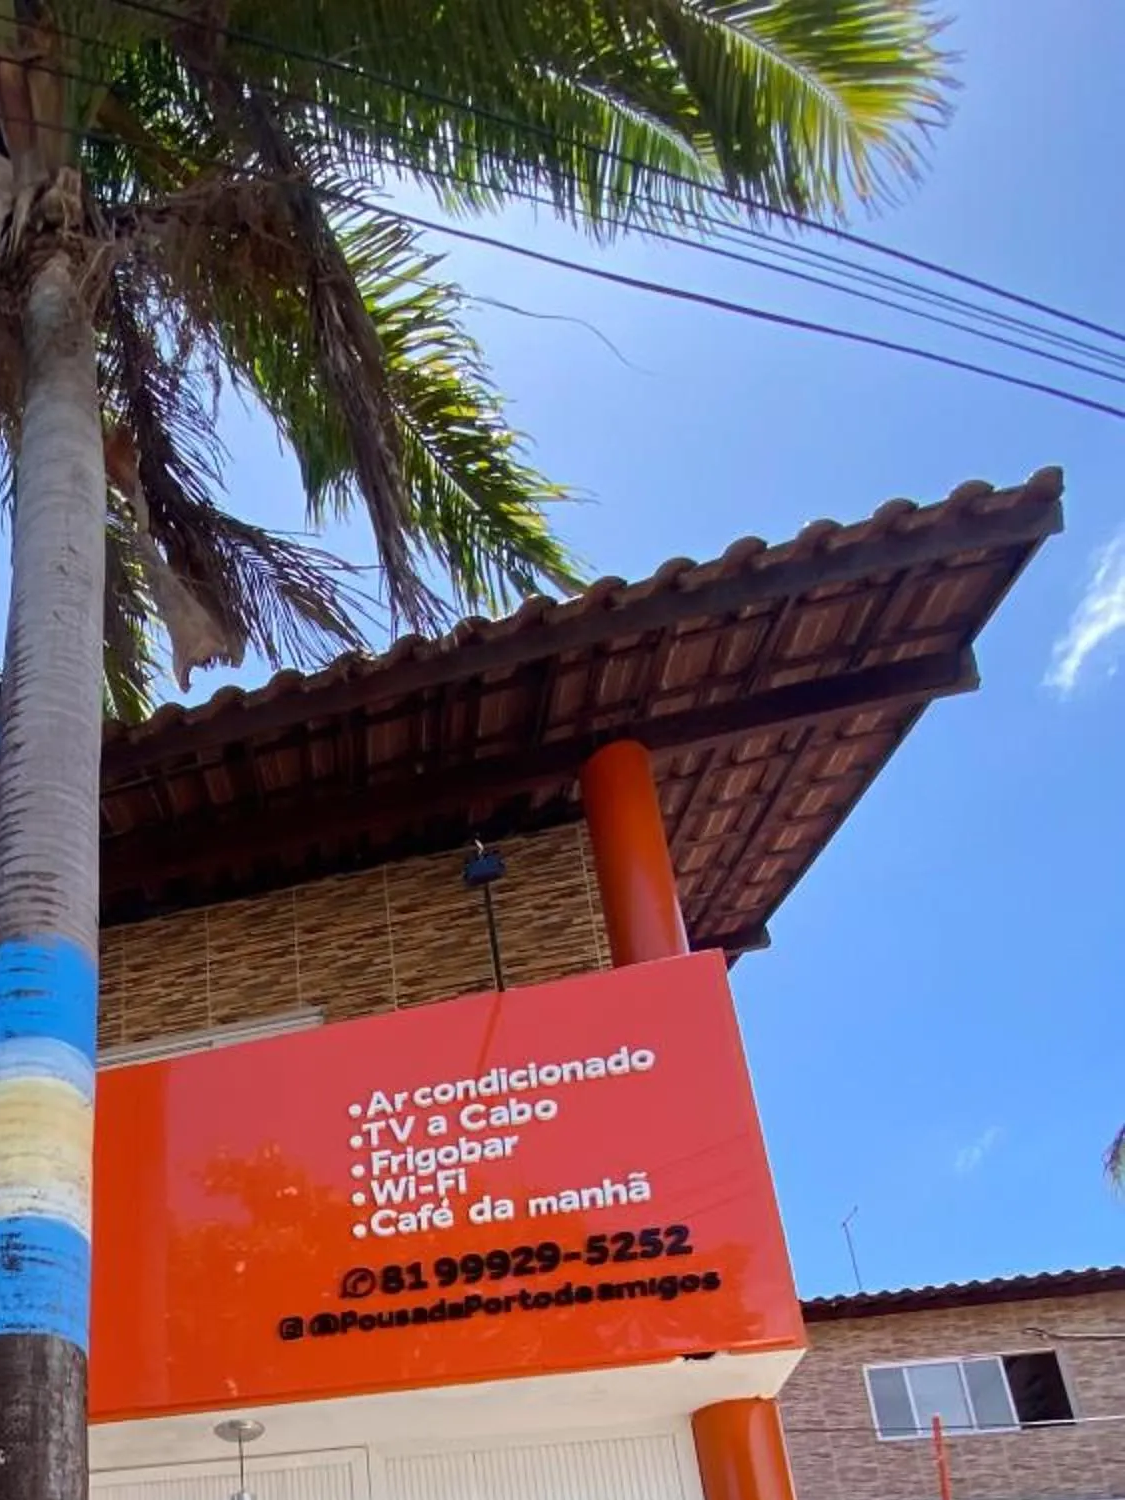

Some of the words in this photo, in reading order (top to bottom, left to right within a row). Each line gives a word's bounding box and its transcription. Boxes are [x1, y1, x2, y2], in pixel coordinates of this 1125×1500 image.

[366, 1090, 409, 1118] Ar
[413, 1046, 655, 1108] condicionado
[362, 1116, 415, 1148] TV
[426, 1114, 448, 1136] a
[459, 1098, 558, 1132] Cabo
[371, 1132, 520, 1177] Frigobar
[370, 1197, 454, 1237] Café
[468, 1195, 515, 1224] da
[528, 1171, 652, 1218] manhã
[371, 1168, 468, 1207] Wi-Fi
[378, 1261, 429, 1296] 81
[433, 1224, 694, 1288] 99929-5252
